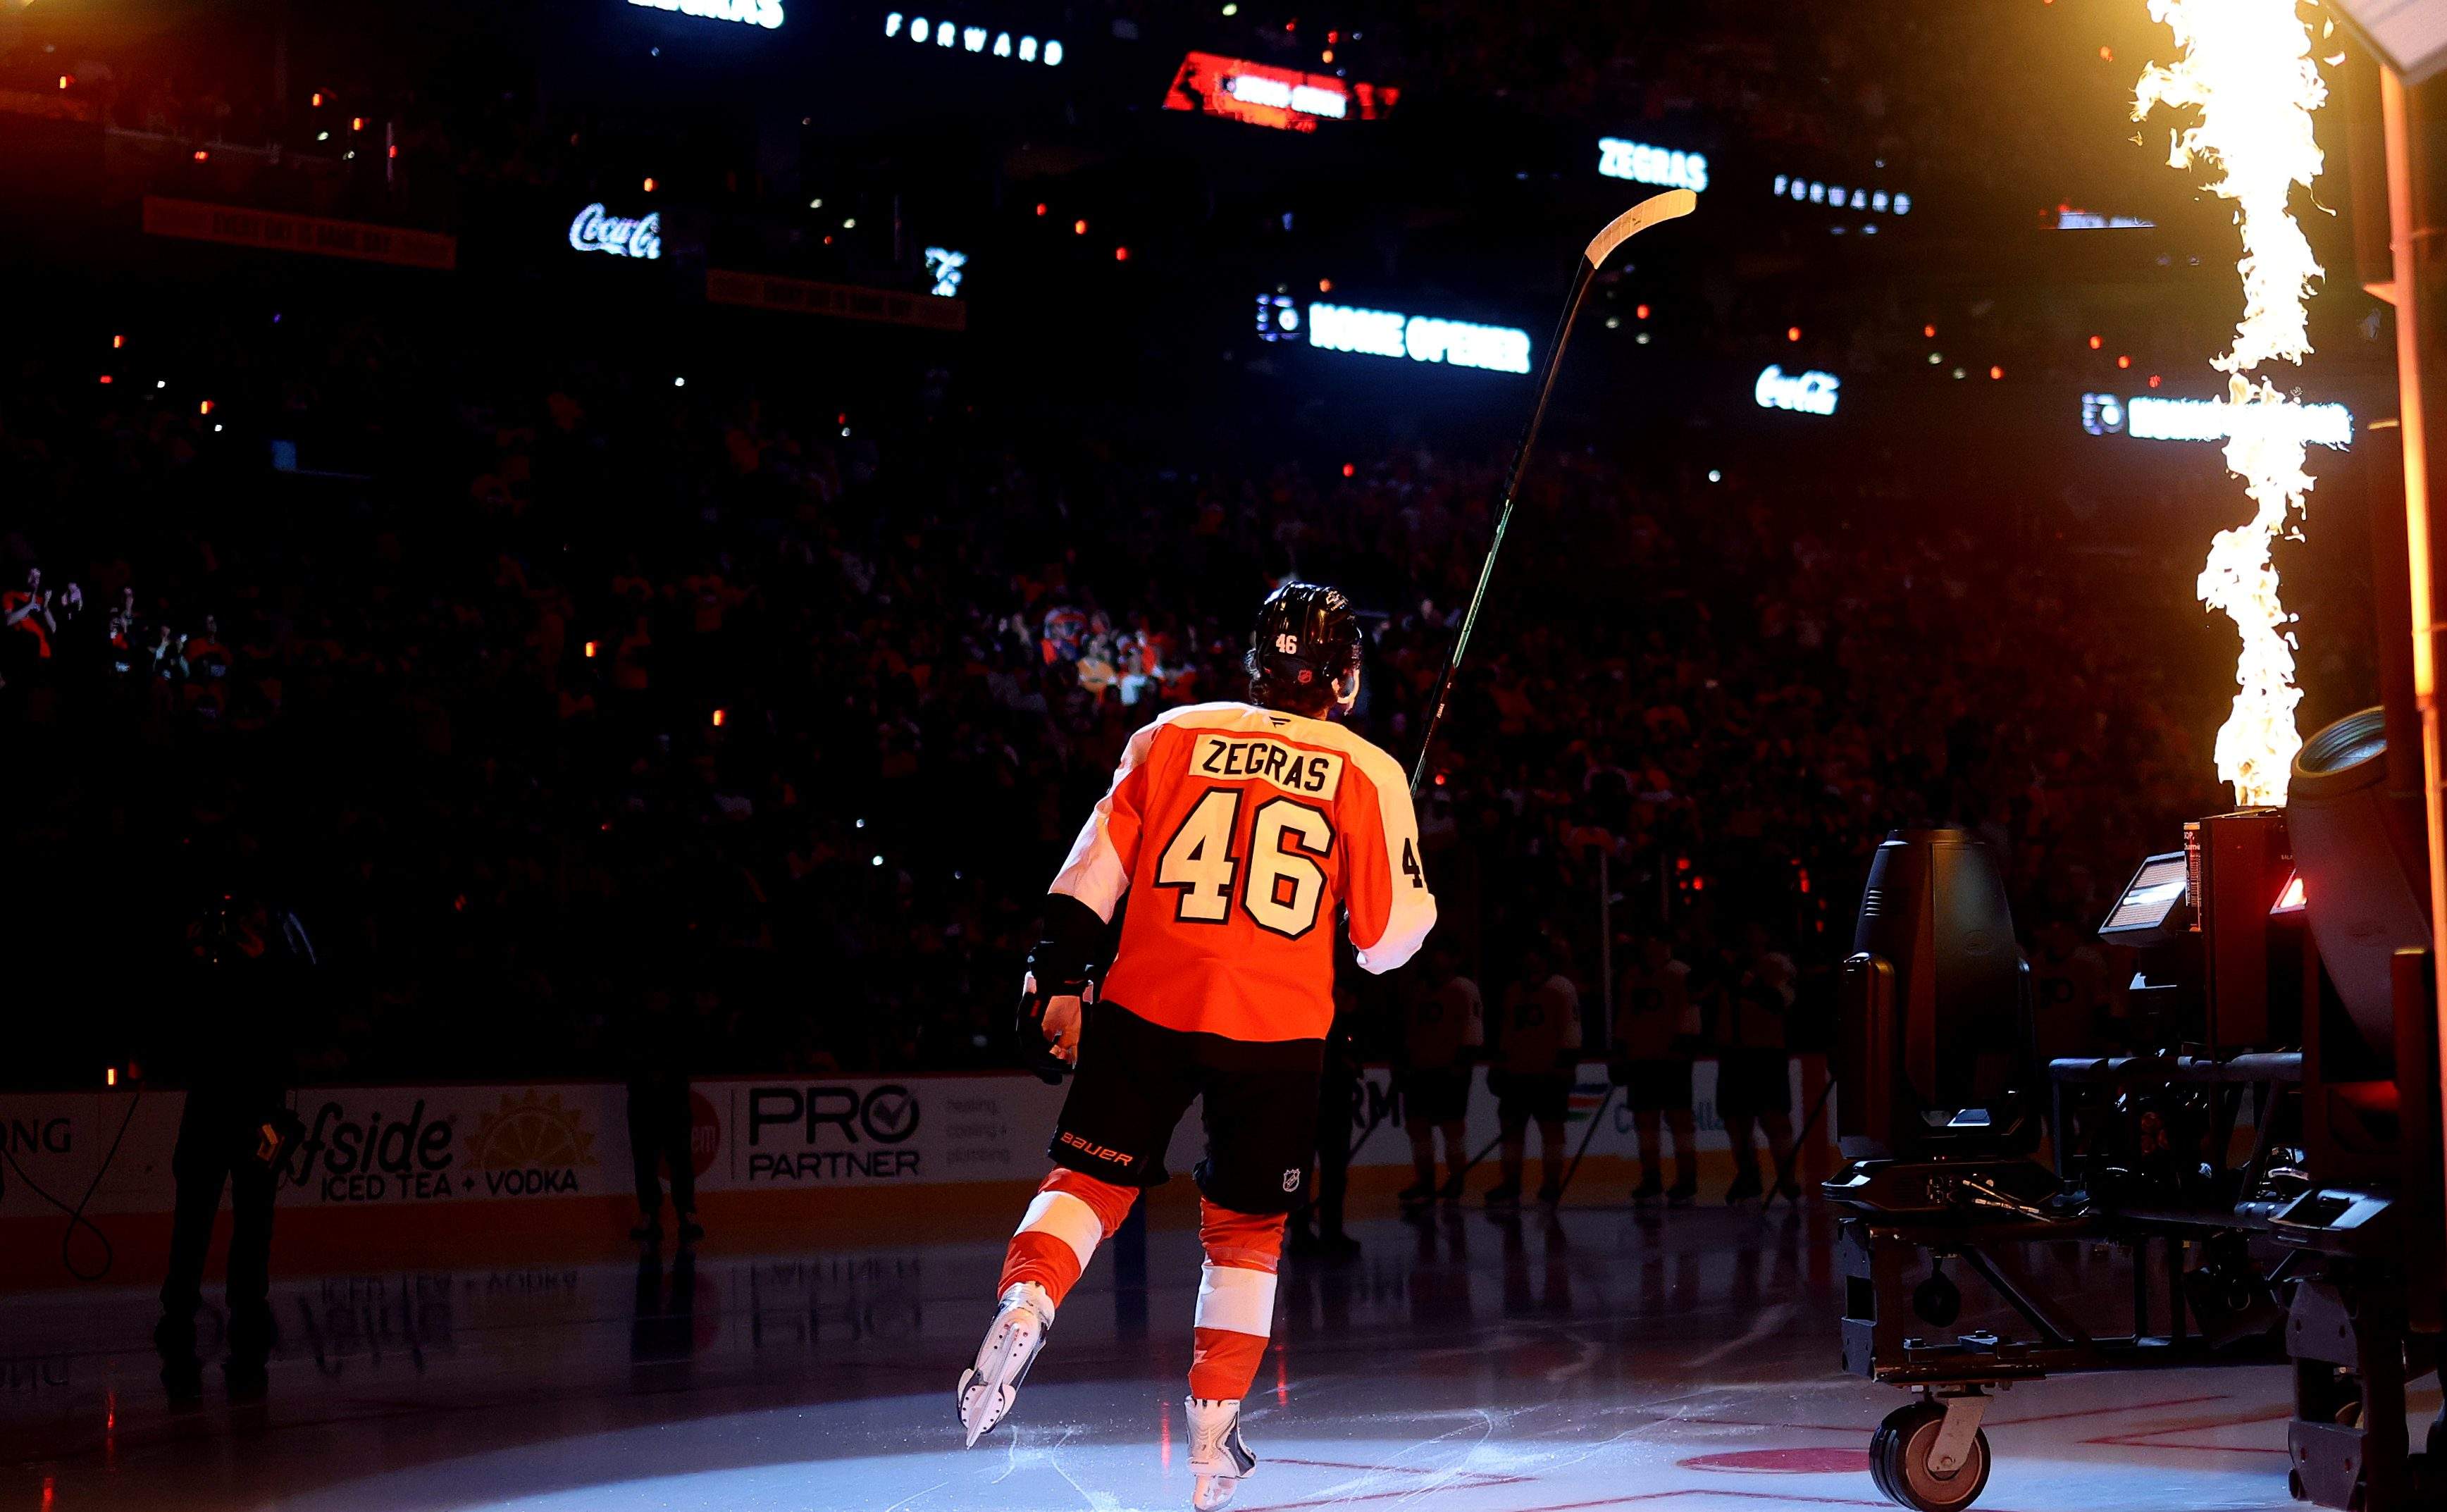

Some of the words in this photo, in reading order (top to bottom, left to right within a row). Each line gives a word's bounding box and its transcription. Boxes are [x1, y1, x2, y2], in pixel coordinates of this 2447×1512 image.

[886, 12, 1063, 66] FORWARD
[1598, 137, 1709, 192] ZEGRAS
[1773, 175, 1910, 216] FORWARD
[1275, 633, 1298, 655] 46
[1201, 738, 1329, 793] ZEGRAS
[1155, 786, 1336, 941] 46
[749, 1084, 920, 1146] PRO
[322, 1174, 385, 1201] ICED
[395, 1172, 452, 1198] TEA
[487, 1168, 579, 1196] VODKA
[749, 1151, 920, 1180] PARTNER
